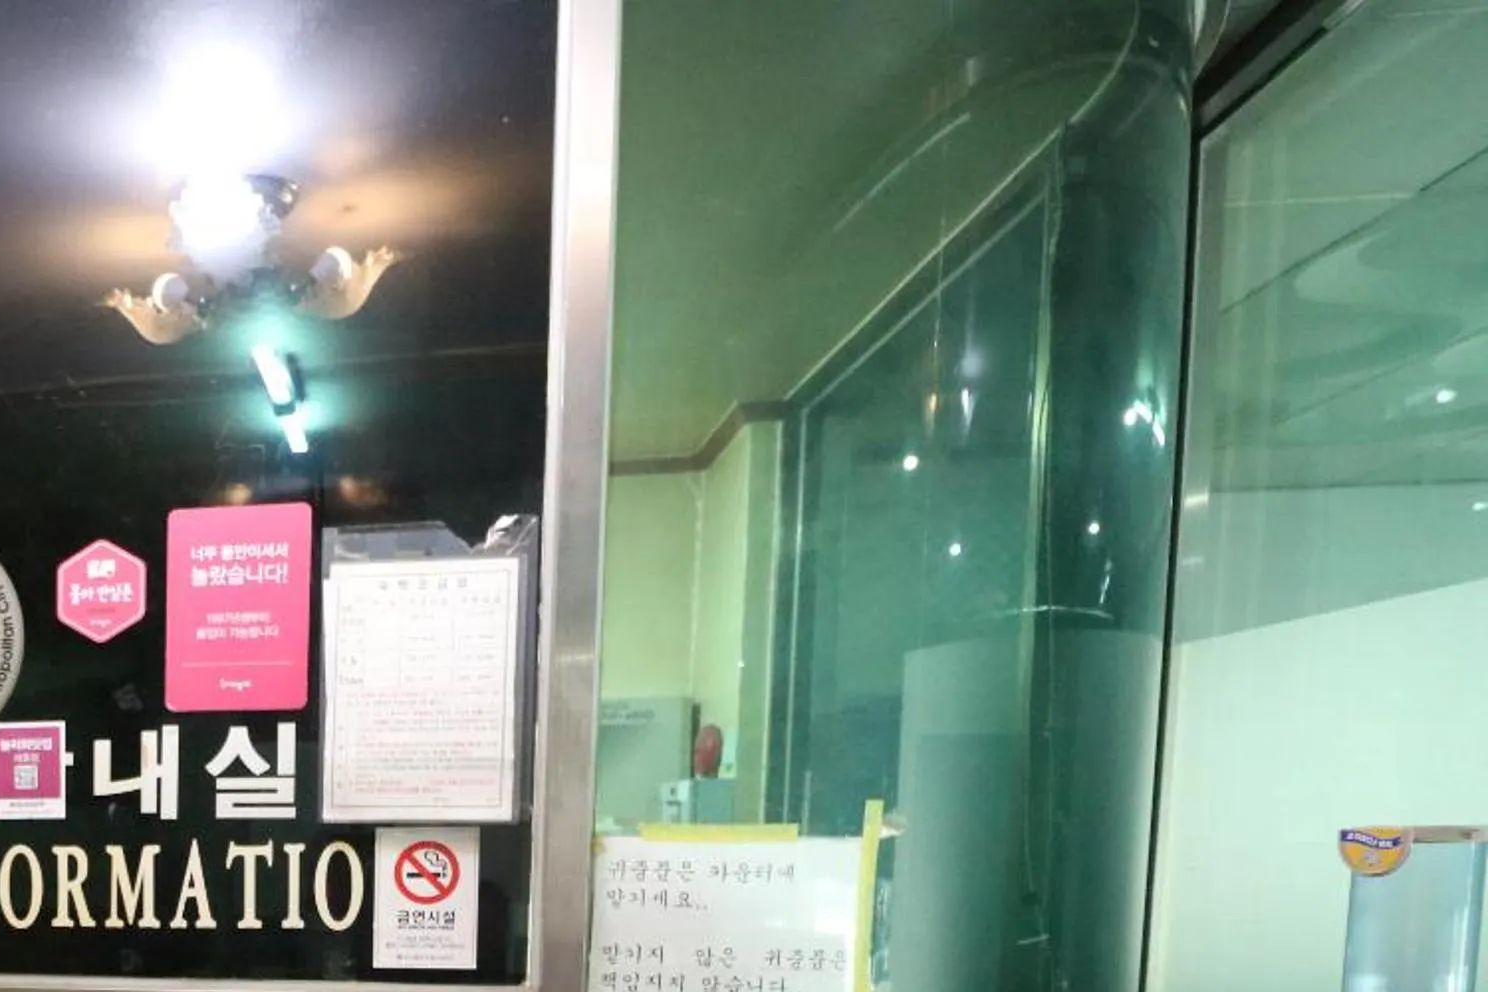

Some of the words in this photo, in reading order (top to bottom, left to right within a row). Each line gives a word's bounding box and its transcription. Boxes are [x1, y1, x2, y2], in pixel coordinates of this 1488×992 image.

[190, 545, 218, 562] 너무
[191, 562, 289, 587] 놀랐습니다!
[608, 858, 696, 883] 귀중품은
[707, 861, 796, 885] 카운터에
[395, 910, 456, 925] 금연시설
[695, 945, 738, 969] 않은
[764, 947, 848, 972] 귀중품은
